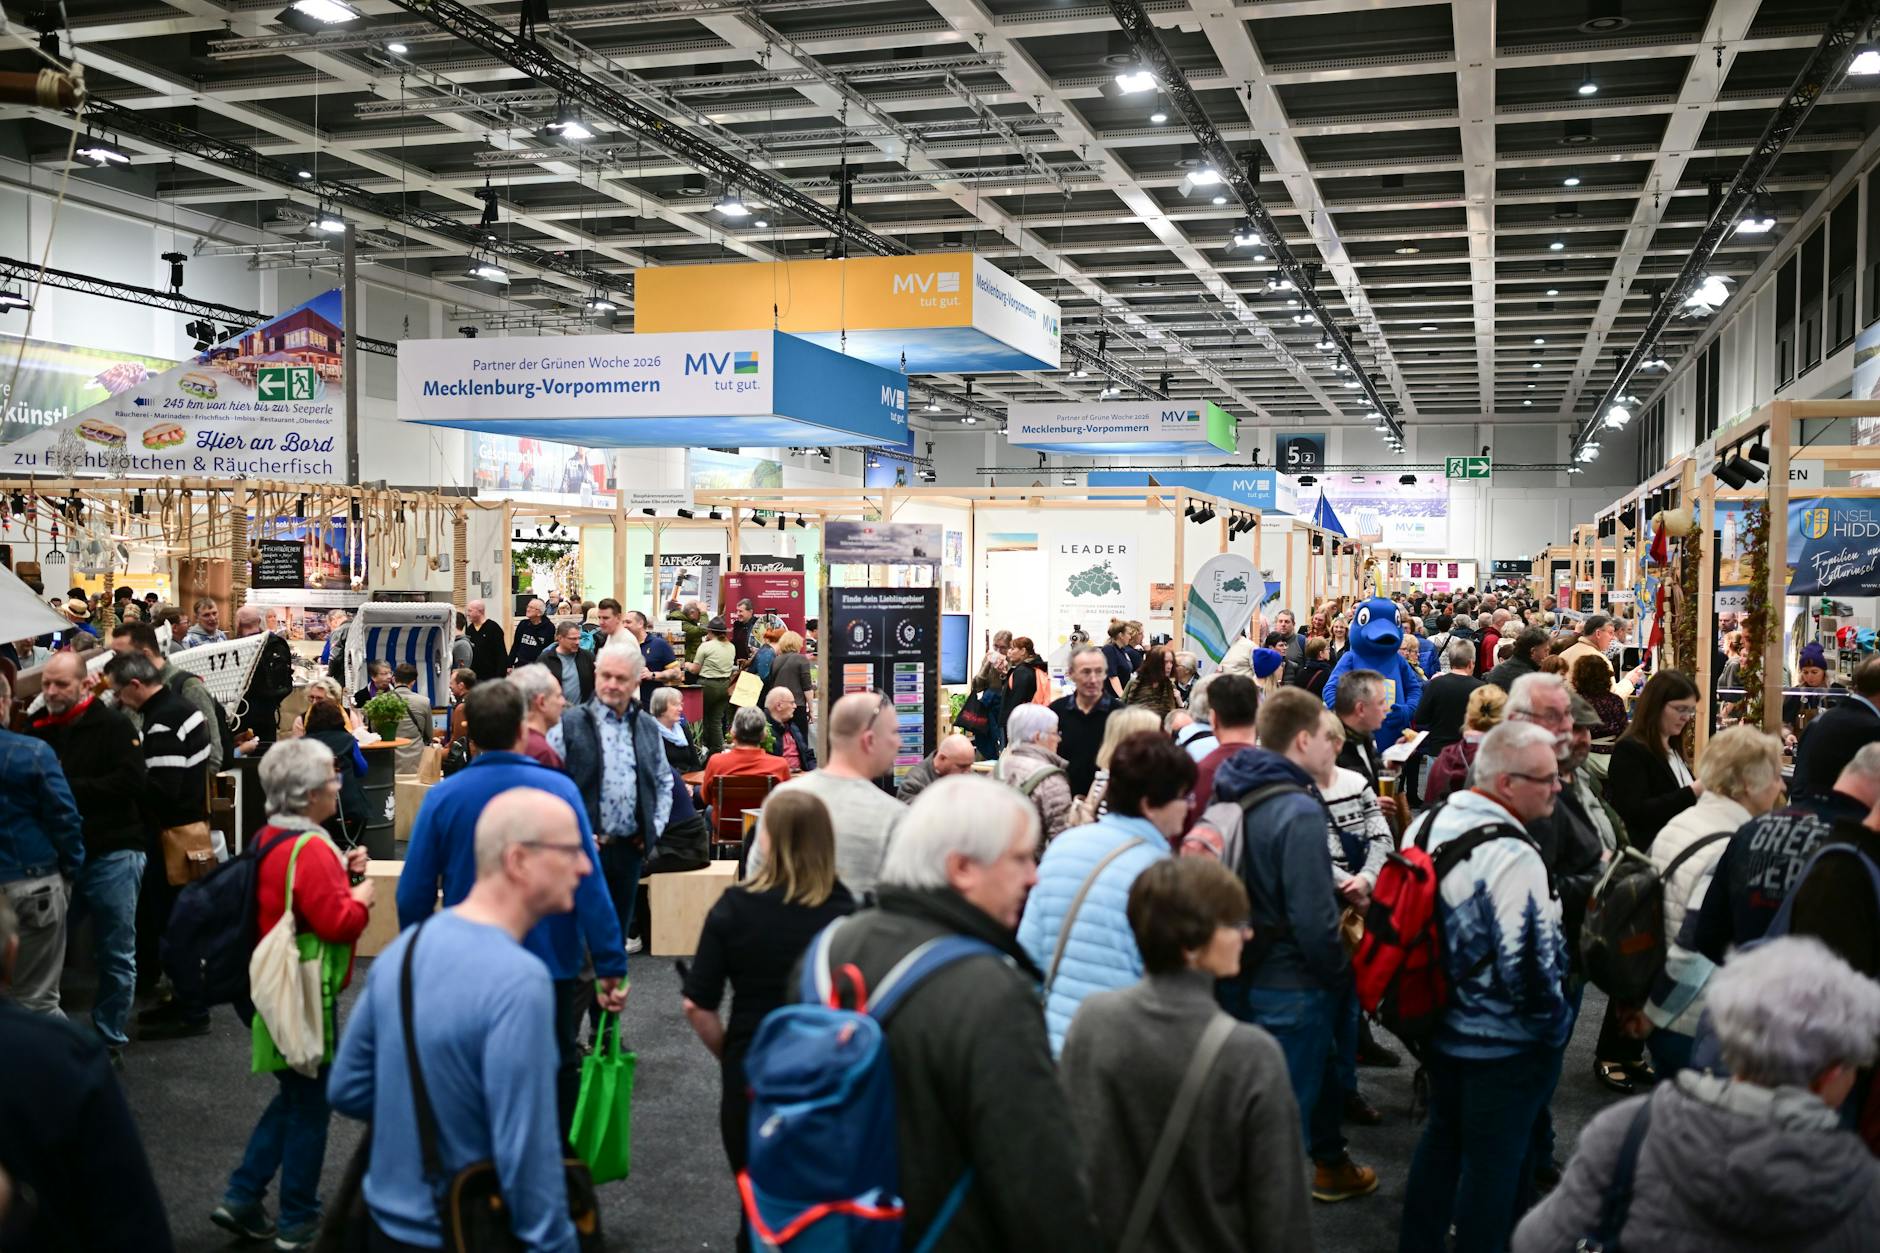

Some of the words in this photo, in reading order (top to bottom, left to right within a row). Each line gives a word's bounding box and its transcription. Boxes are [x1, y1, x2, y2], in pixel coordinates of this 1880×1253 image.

[892, 272, 935, 294] MV
[920, 297, 936, 307] tut
[976, 273, 1037, 319] Mecklenburg-Vorpommern
[1042, 312, 1053, 332] MV
[473, 358, 516, 371] Partner
[519, 357, 538, 370] der
[541, 357, 585, 369] Grünen
[589, 356, 630, 369] Woche
[633, 355, 661, 367] 2026
[684, 352, 730, 375] MV
[423, 377, 661, 398] Mecklenburg-Vorpommern
[714, 381, 733, 390] tut
[736, 379, 760, 392] gut.
[881, 384, 897, 407] MV
[163, 398, 184, 409] 245
[186, 399, 205, 410] km
[206, 402, 227, 410] von
[229, 400, 251, 411] hier
[253, 401, 270, 412] bis
[271, 403, 290, 413] zur
[292, 403, 333, 415] Seeperle
[154, 412, 190, 420] Marinaden
[1161, 410, 1185, 422] MV
[1021, 423, 1149, 434] Mecklenburg-Vorpommern
[196, 430, 248, 452] Hier
[250, 436, 276, 450] an
[280, 432, 335, 452] Bord
[1287, 446, 1300, 464] 5
[1305, 454, 1311, 462] 2
[14, 453, 36, 465] zu
[193, 457, 206, 471] &
[214, 456, 333, 475] Räucherfisch
[1232, 480, 1256, 491] MV
[1833, 509, 1878, 522] INSEL
[1395, 523, 1415, 531] MV
[1061, 544, 1126, 554] LEADER
[842, 594, 861, 603] Finde
[862, 594, 878, 603] dein
[879, 594, 925, 604] Lieblingsbier!
